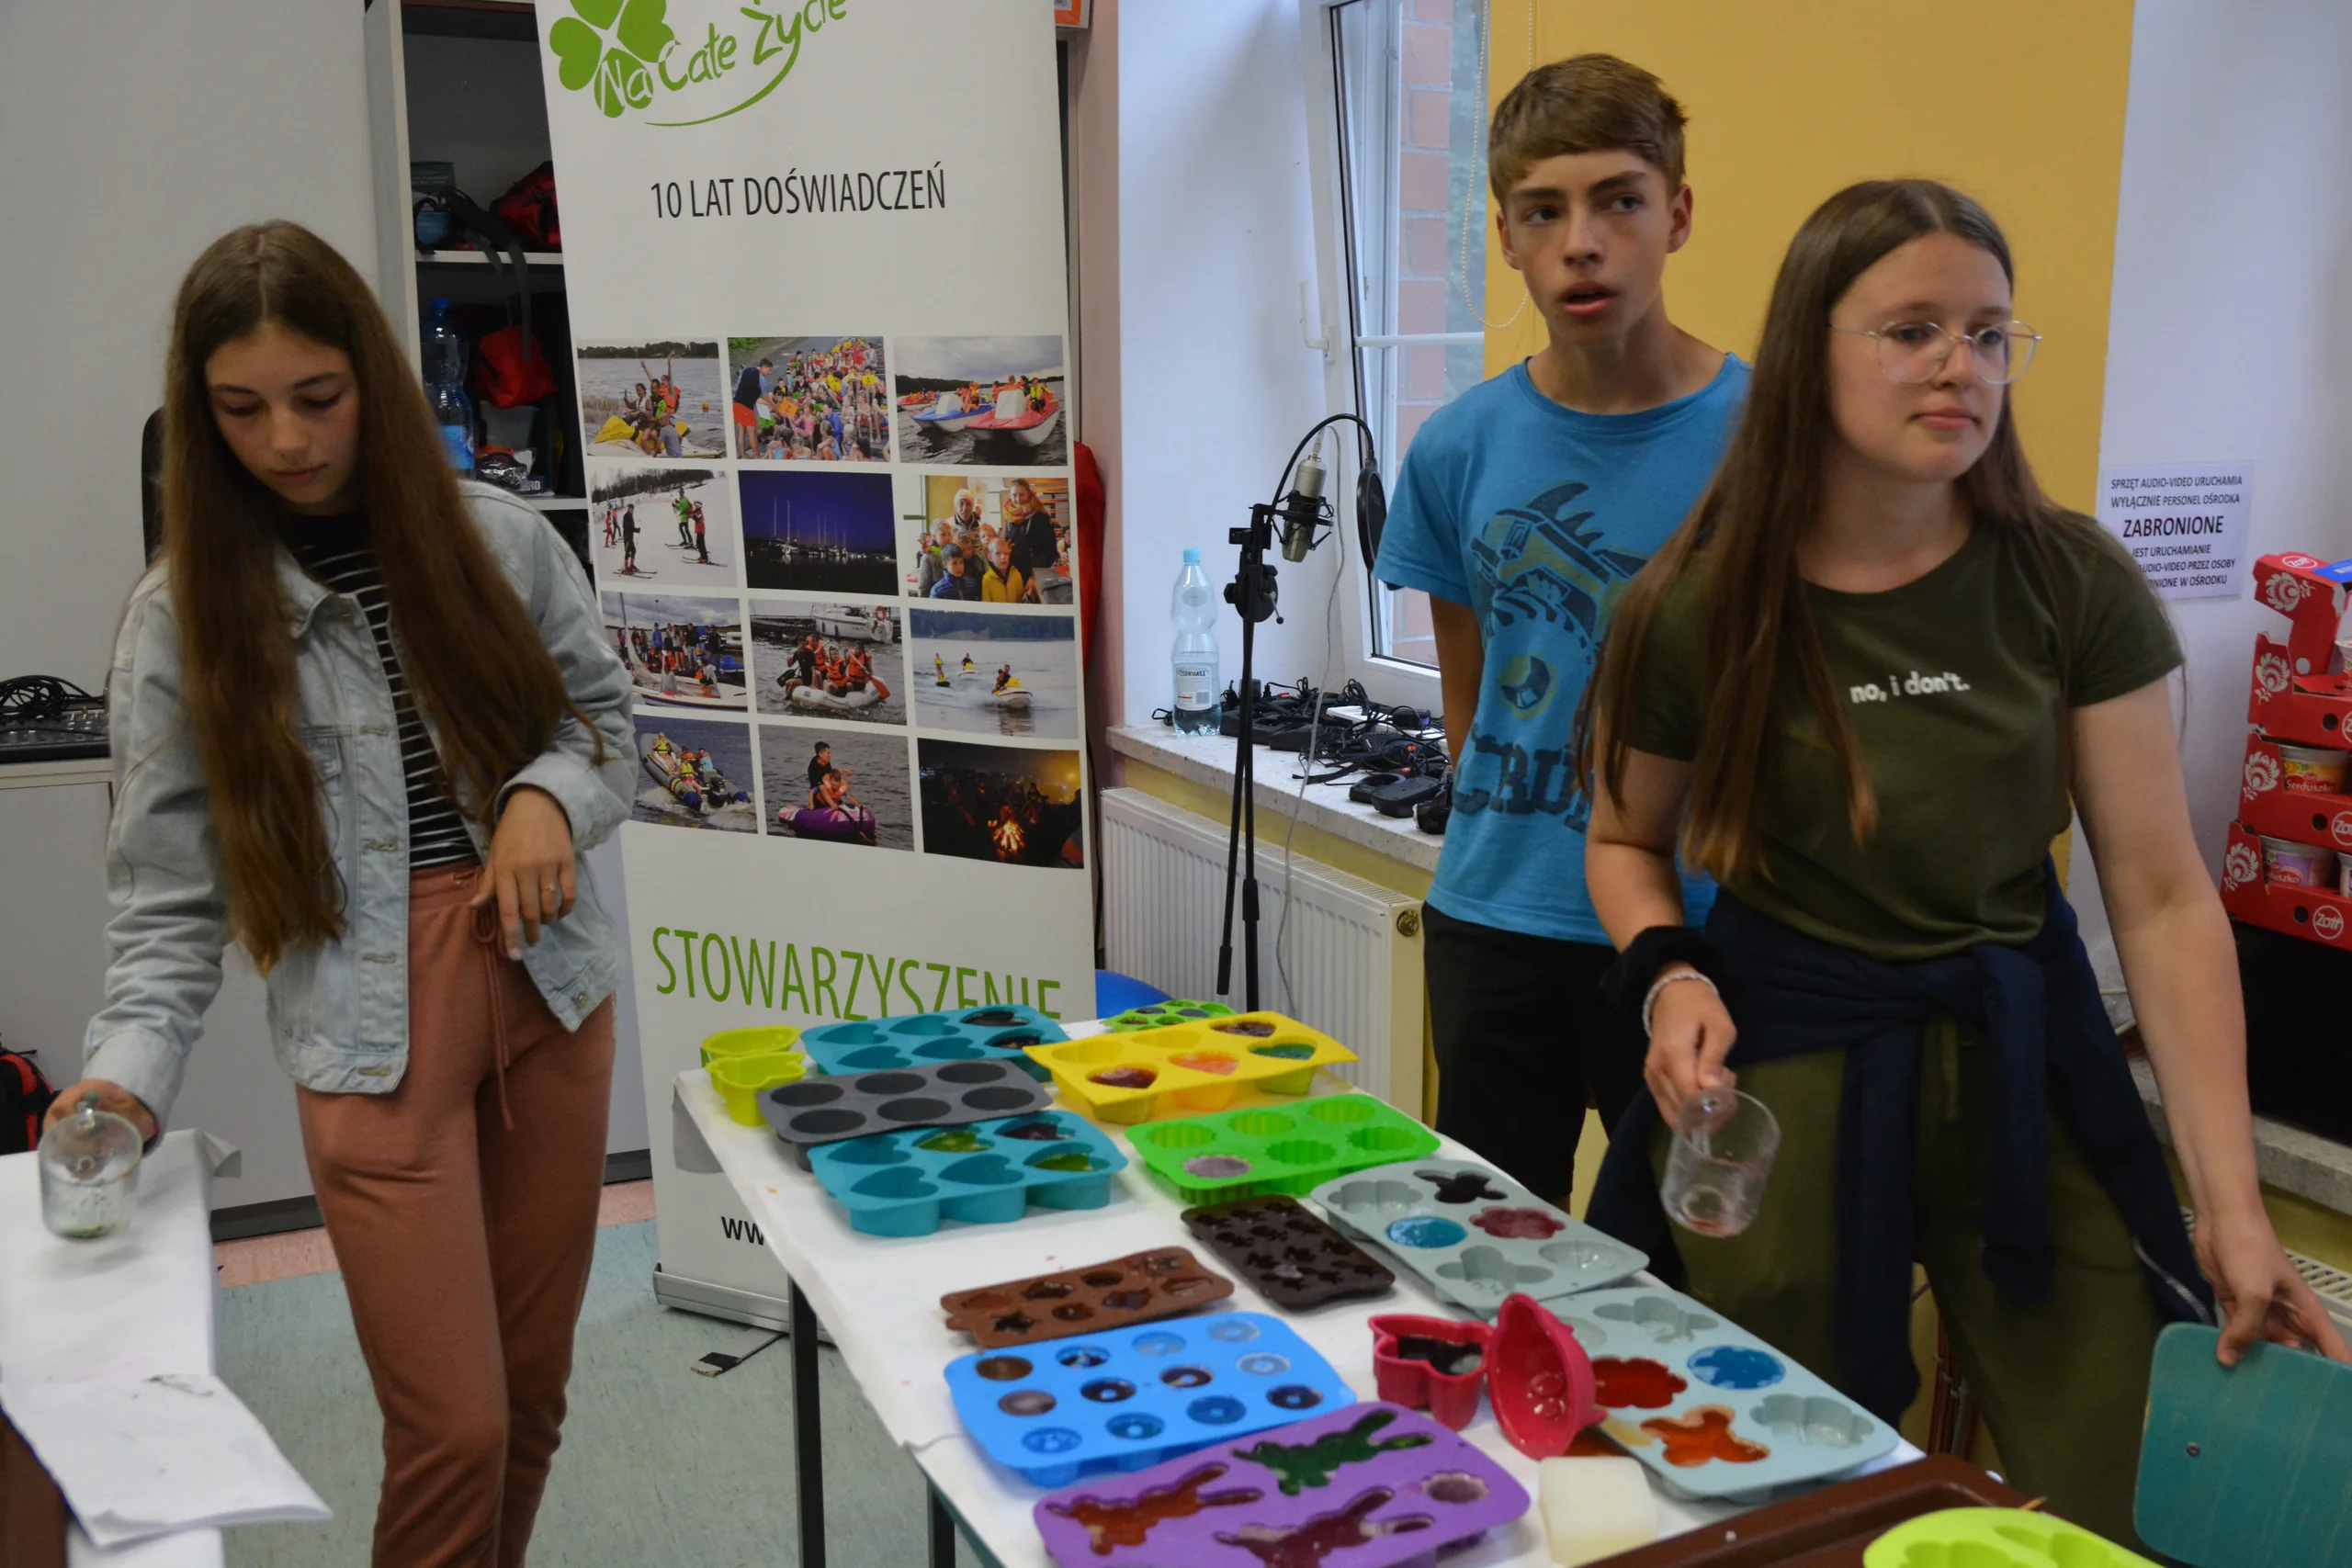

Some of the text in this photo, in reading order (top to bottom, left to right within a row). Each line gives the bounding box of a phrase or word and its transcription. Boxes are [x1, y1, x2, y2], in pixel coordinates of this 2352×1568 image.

[599, 59, 653, 114] Na
[650, 161, 946, 219] 10 LAT DOŚWIADCZEŃ
[2110, 476, 2243, 491] SPRZĘT AUDIO-VIDEO URUCHAMIA
[2110, 492, 2240, 510] WYŁĄCZNIE PERSONEL OŚRODKA
[2123, 515, 2224, 538] ZABRONIONE
[2150, 544, 2211, 557] URUCHAMIANIE
[2188, 559, 2210, 570] PRZEZ
[2211, 558, 2235, 569] OSOBY
[2178, 576, 2188, 587] W
[2189, 573, 2228, 587] OŚRODKU
[1849, 683, 1887, 704] no,
[1889, 674, 1901, 696] i
[652, 926, 1061, 1021] STOWARZYSZENIE
